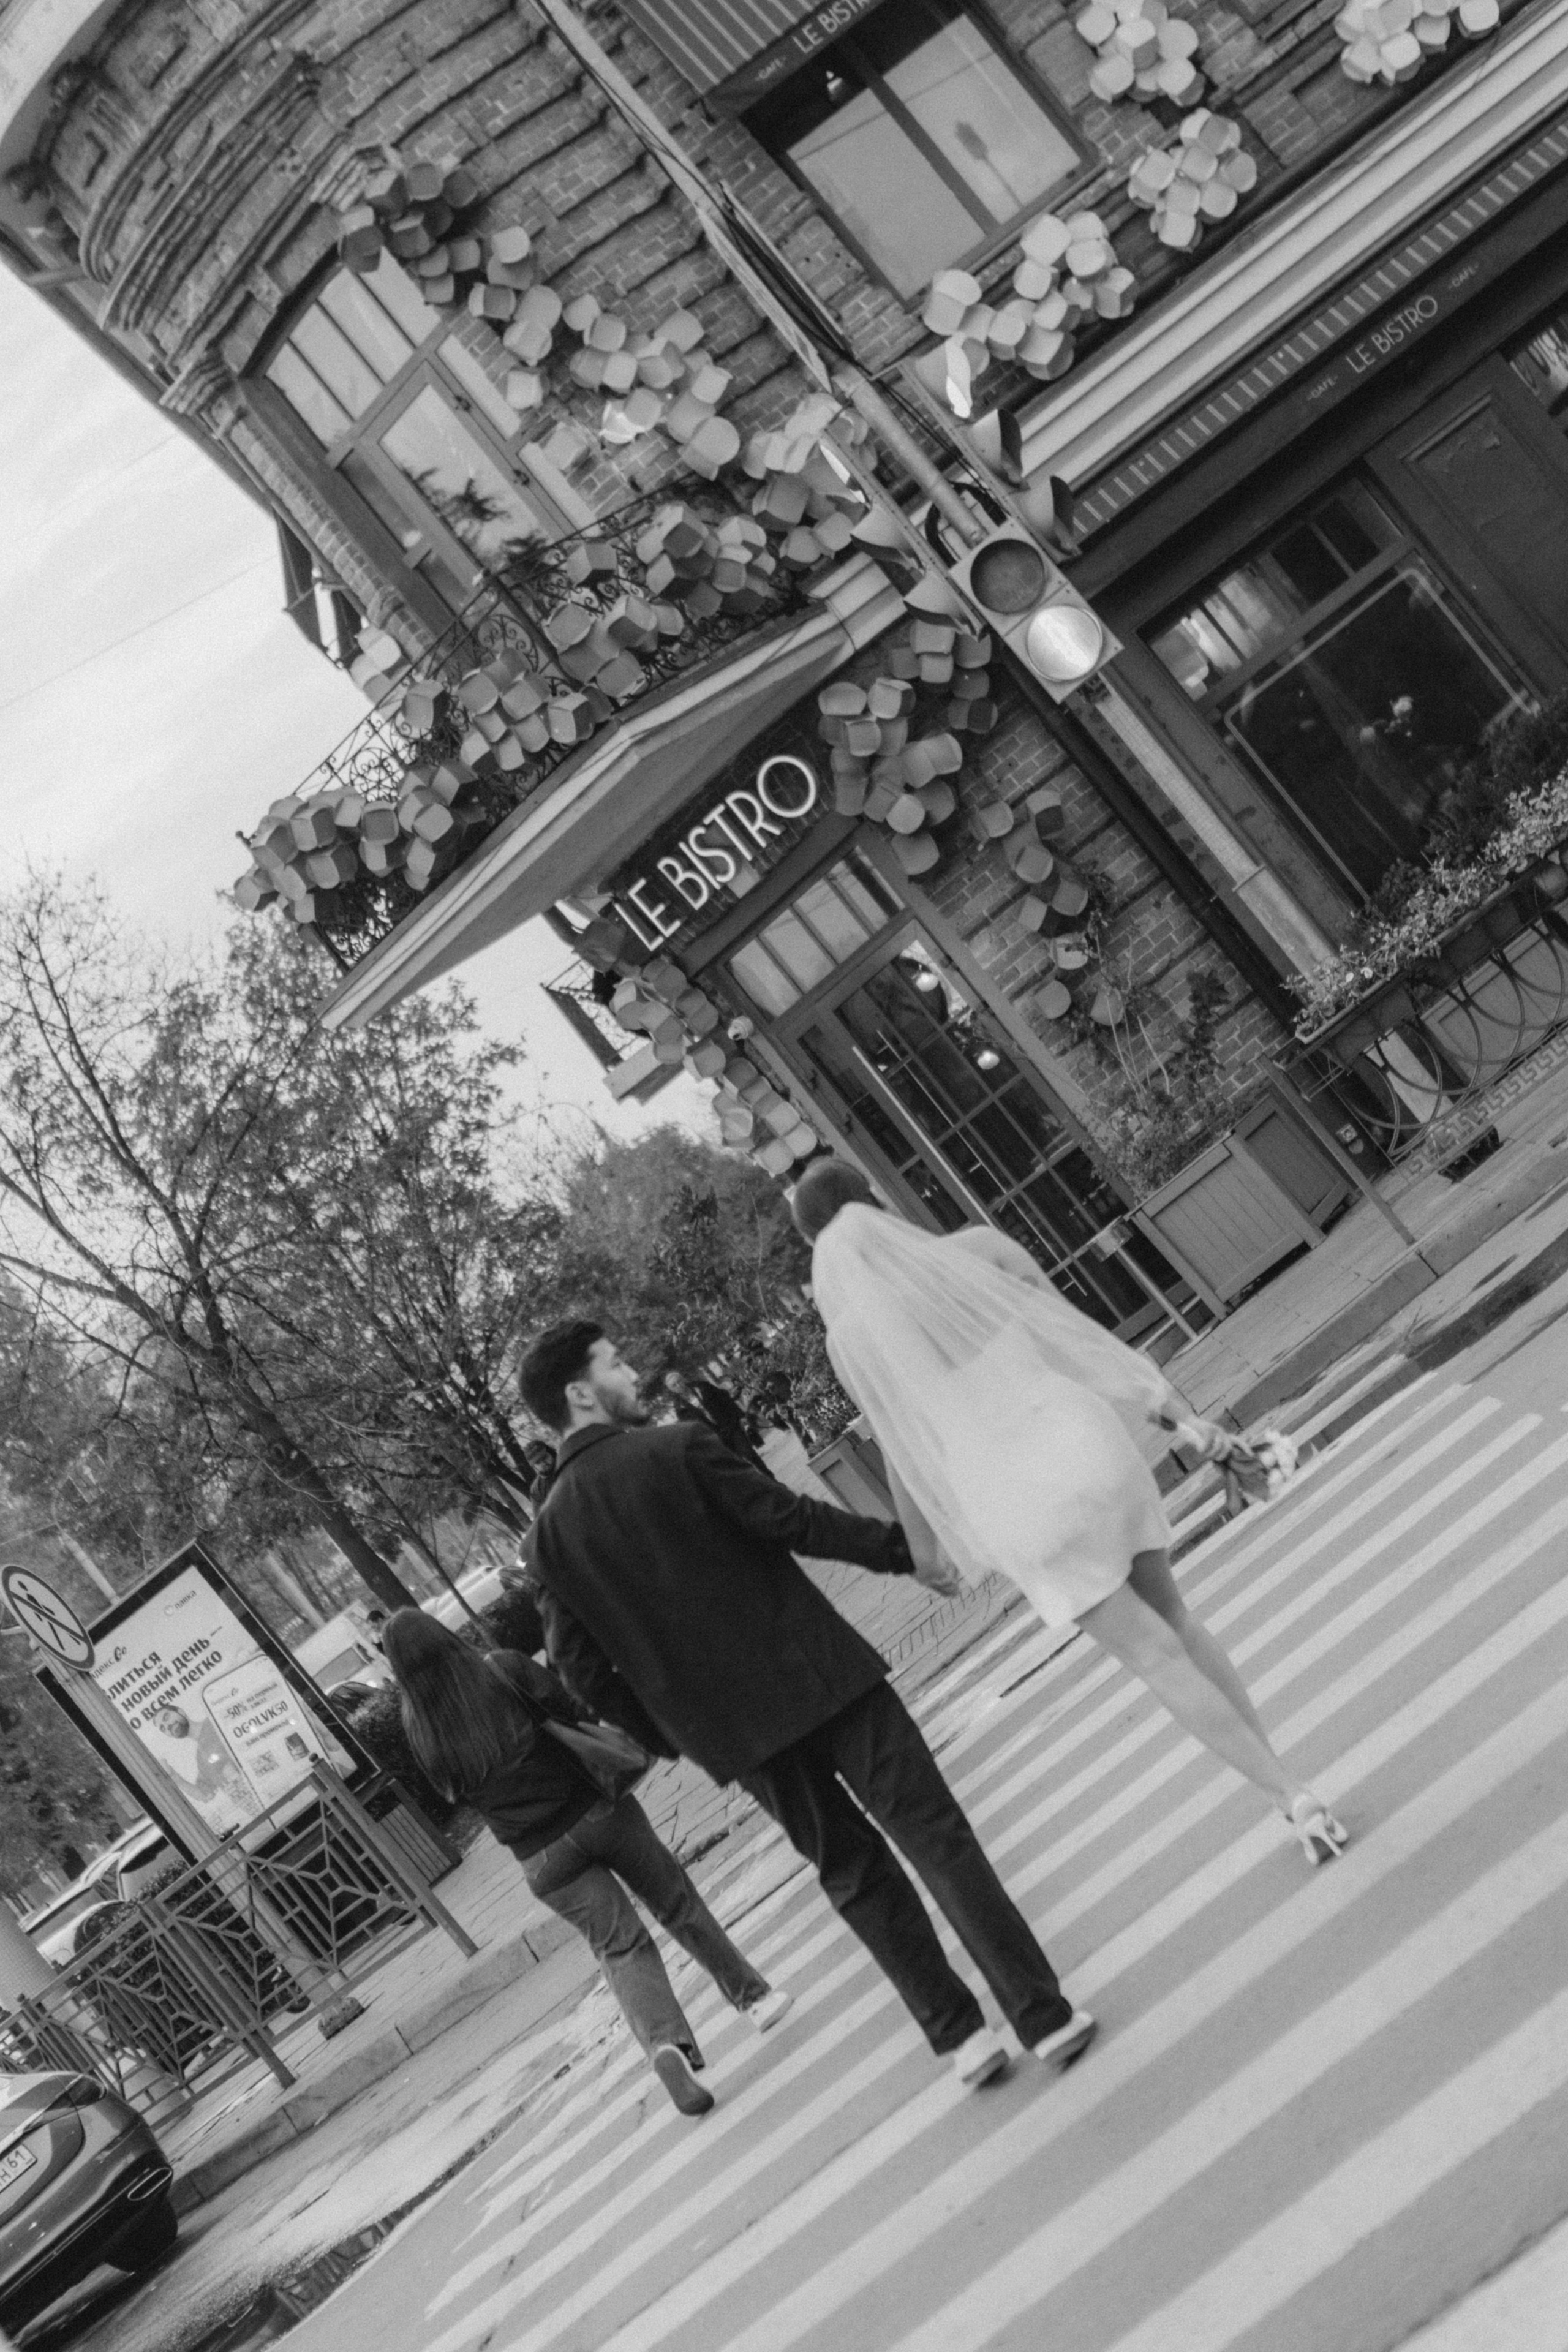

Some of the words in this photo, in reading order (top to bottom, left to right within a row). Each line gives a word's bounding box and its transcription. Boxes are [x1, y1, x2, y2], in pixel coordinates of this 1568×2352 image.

[791, 23, 824, 53] LE
[817, 0, 870, 33] BIST
[1346, 343, 1376, 374] LE
[1371, 295, 1438, 354] BISTRO
[614, 878, 681, 952] LE
[657, 754, 817, 910] BISTRO
[107, 1651, 162, 1700] литься
[121, 1665, 172, 1713] новый
[171, 1638, 210, 1675] день
[141, 1685, 181, 1721] всем
[179, 1651, 222, 1691] легко
[0, 2168, 12, 2186] H
[7, 2150, 26, 2169] 61
